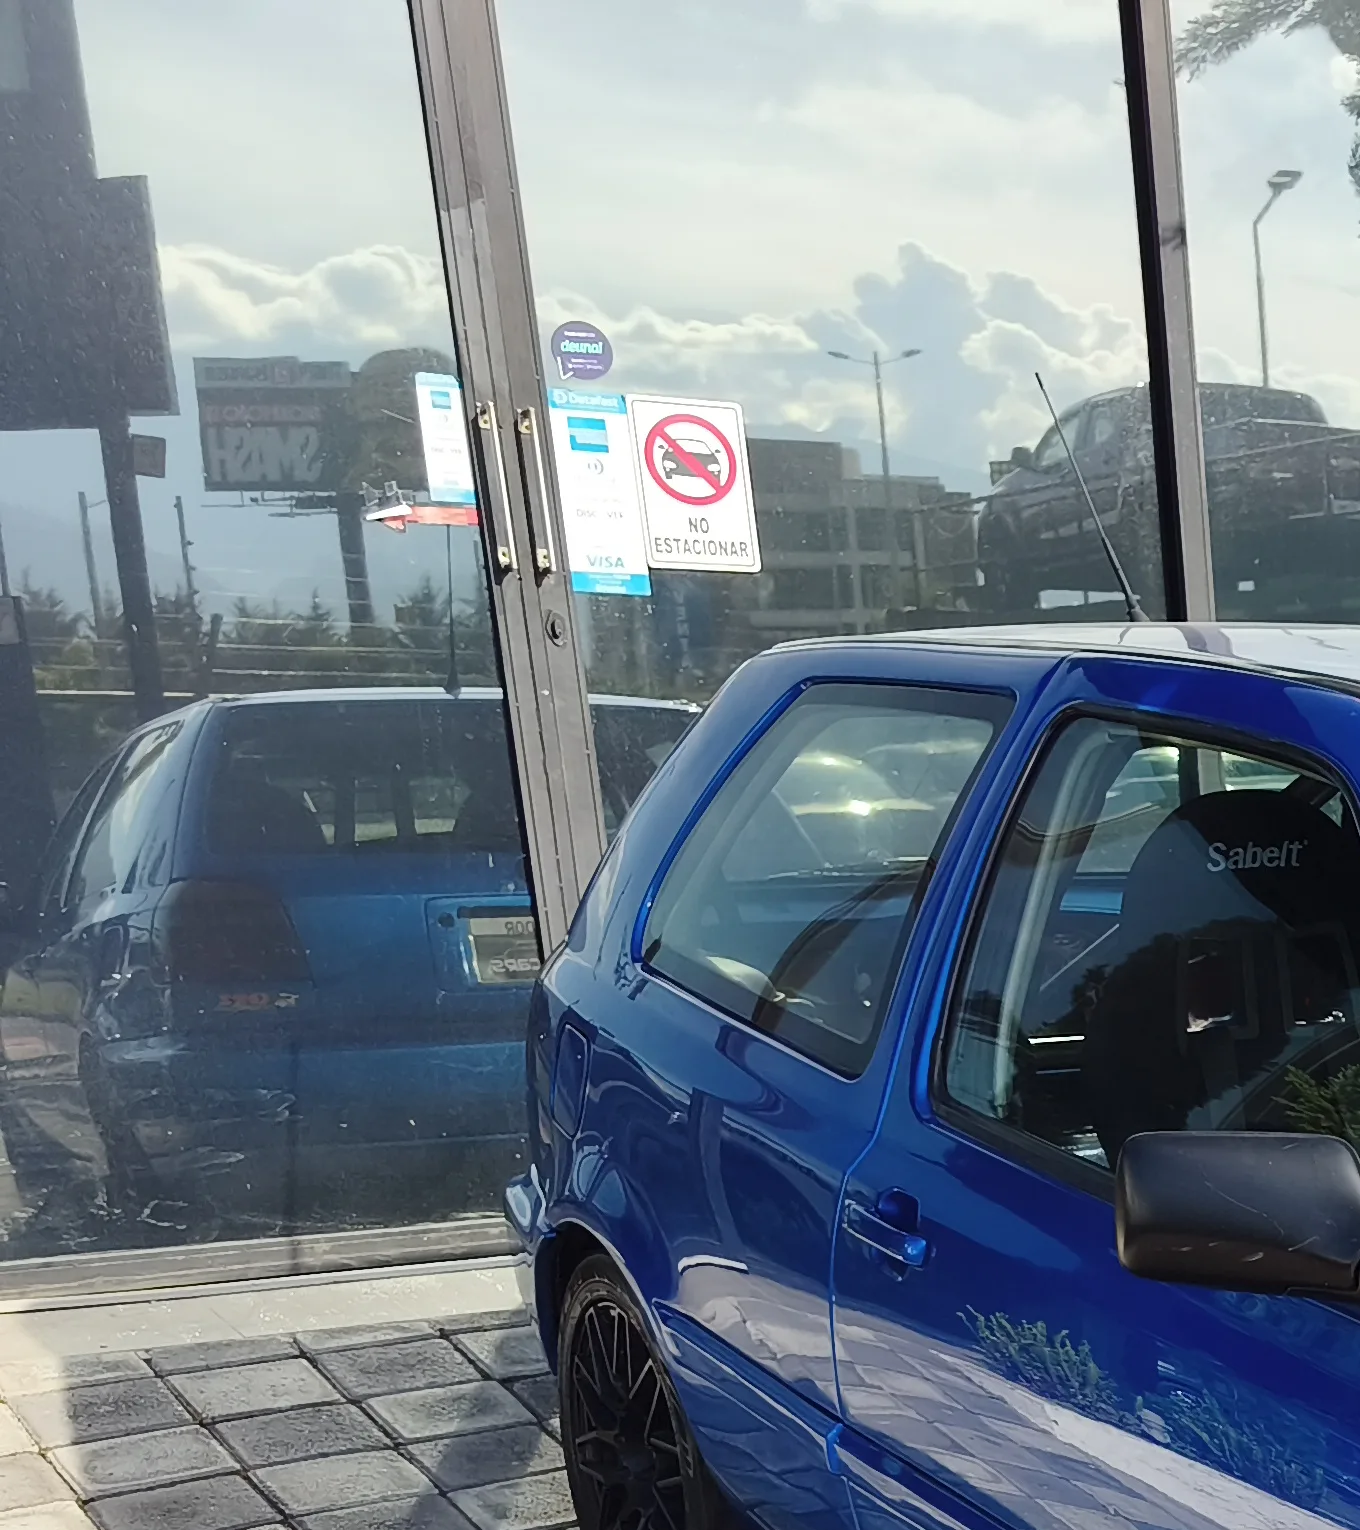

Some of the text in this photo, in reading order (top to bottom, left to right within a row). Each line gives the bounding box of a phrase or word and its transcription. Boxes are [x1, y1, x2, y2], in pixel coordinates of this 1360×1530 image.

[688, 517, 710, 533] NO
[654, 537, 749, 557] ESTACIONAR
[586, 554, 626, 569] VISA
[1206, 841, 1303, 872] Sabelt
